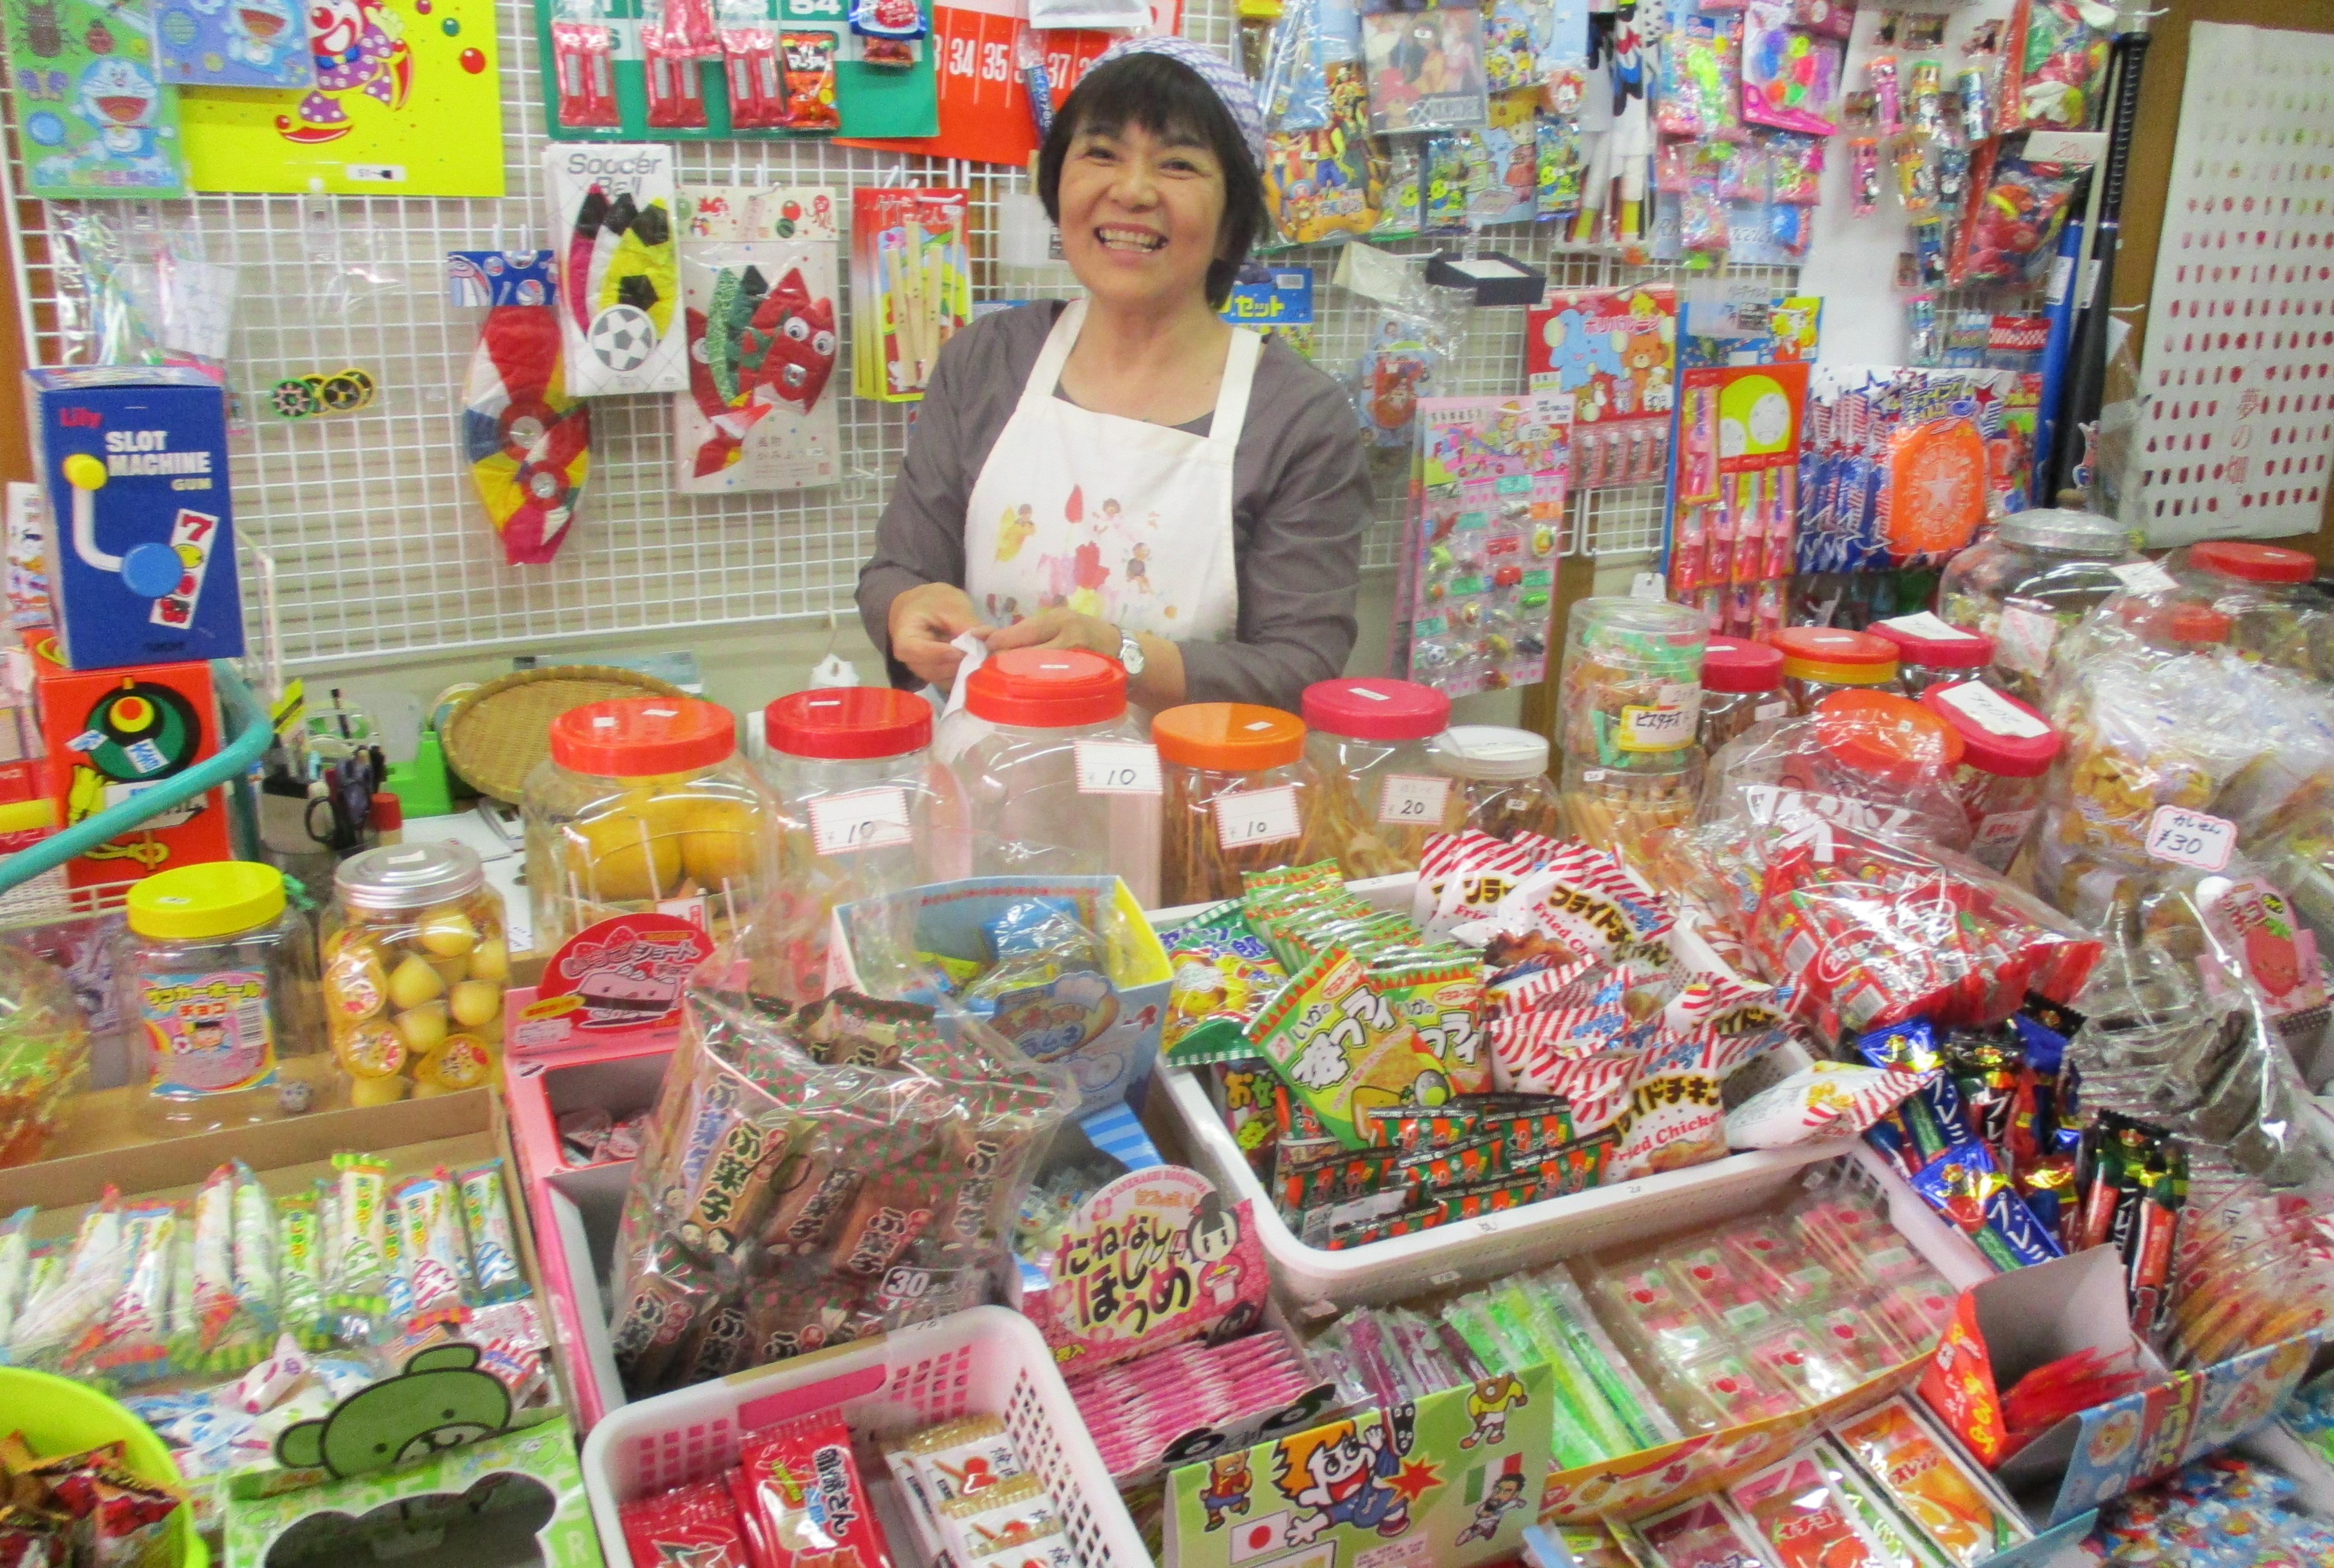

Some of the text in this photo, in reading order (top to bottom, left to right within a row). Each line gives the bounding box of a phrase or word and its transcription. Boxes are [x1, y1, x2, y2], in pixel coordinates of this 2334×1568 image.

[950, 38, 976, 77] 34
[982, 42, 1009, 82] 35
[568, 154, 661, 175] Soccer
[105, 431, 168, 452] SLOT
[106, 451, 213, 476] MACHINE
[182, 515, 214, 541] 7
[1107, 769, 1136, 786] 10
[1399, 799, 1425, 816] 20
[847, 821, 874, 843] 10
[1246, 821, 1268, 838] 10
[179, 1002, 227, 1017] チョコ
[1055, 1214, 1172, 1276] たねなし
[887, 1270, 930, 1297] 30
[1079, 1248, 1191, 1334] ほしうめ
